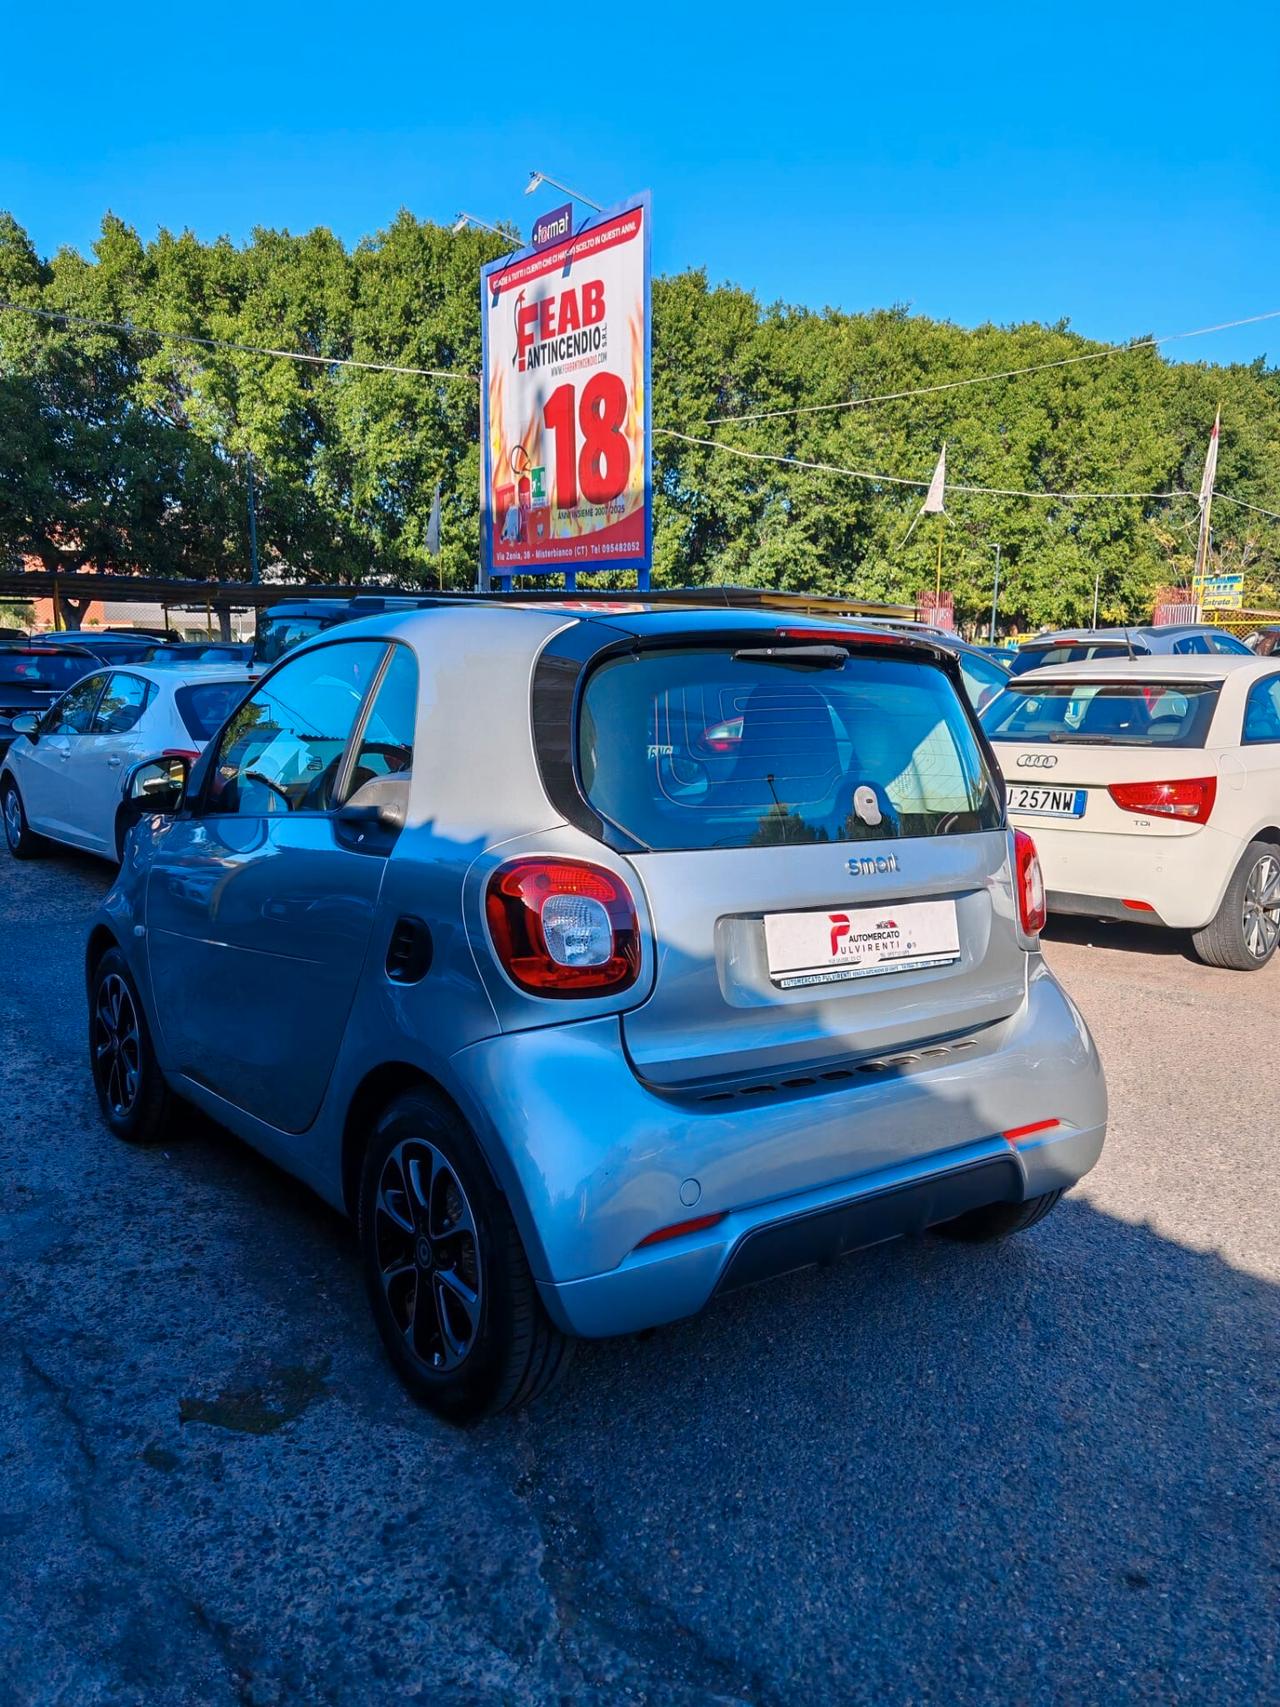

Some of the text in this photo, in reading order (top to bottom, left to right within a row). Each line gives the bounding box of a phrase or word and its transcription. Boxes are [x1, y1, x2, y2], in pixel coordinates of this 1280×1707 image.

[537, 212, 569, 244] format
[601, 229, 621, 243] QUESTI
[517, 279, 606, 362] FEAB
[527, 327, 601, 371] ANTINCENDIO
[543, 371, 631, 510] 18
[496, 552, 505, 561] Via
[535, 547, 573, 559] Misterbianco
[574, 545, 588, 557] (CT)
[590, 544, 601, 555] Tel
[1018, 789, 1074, 812] 257NW
[1133, 819, 1151, 827] TDI
[847, 852, 901, 877] smart
[848, 930, 901, 943] AUTOMERCATO
[782, 970, 852, 988] AUTOMERCATO PULVIRENTI
